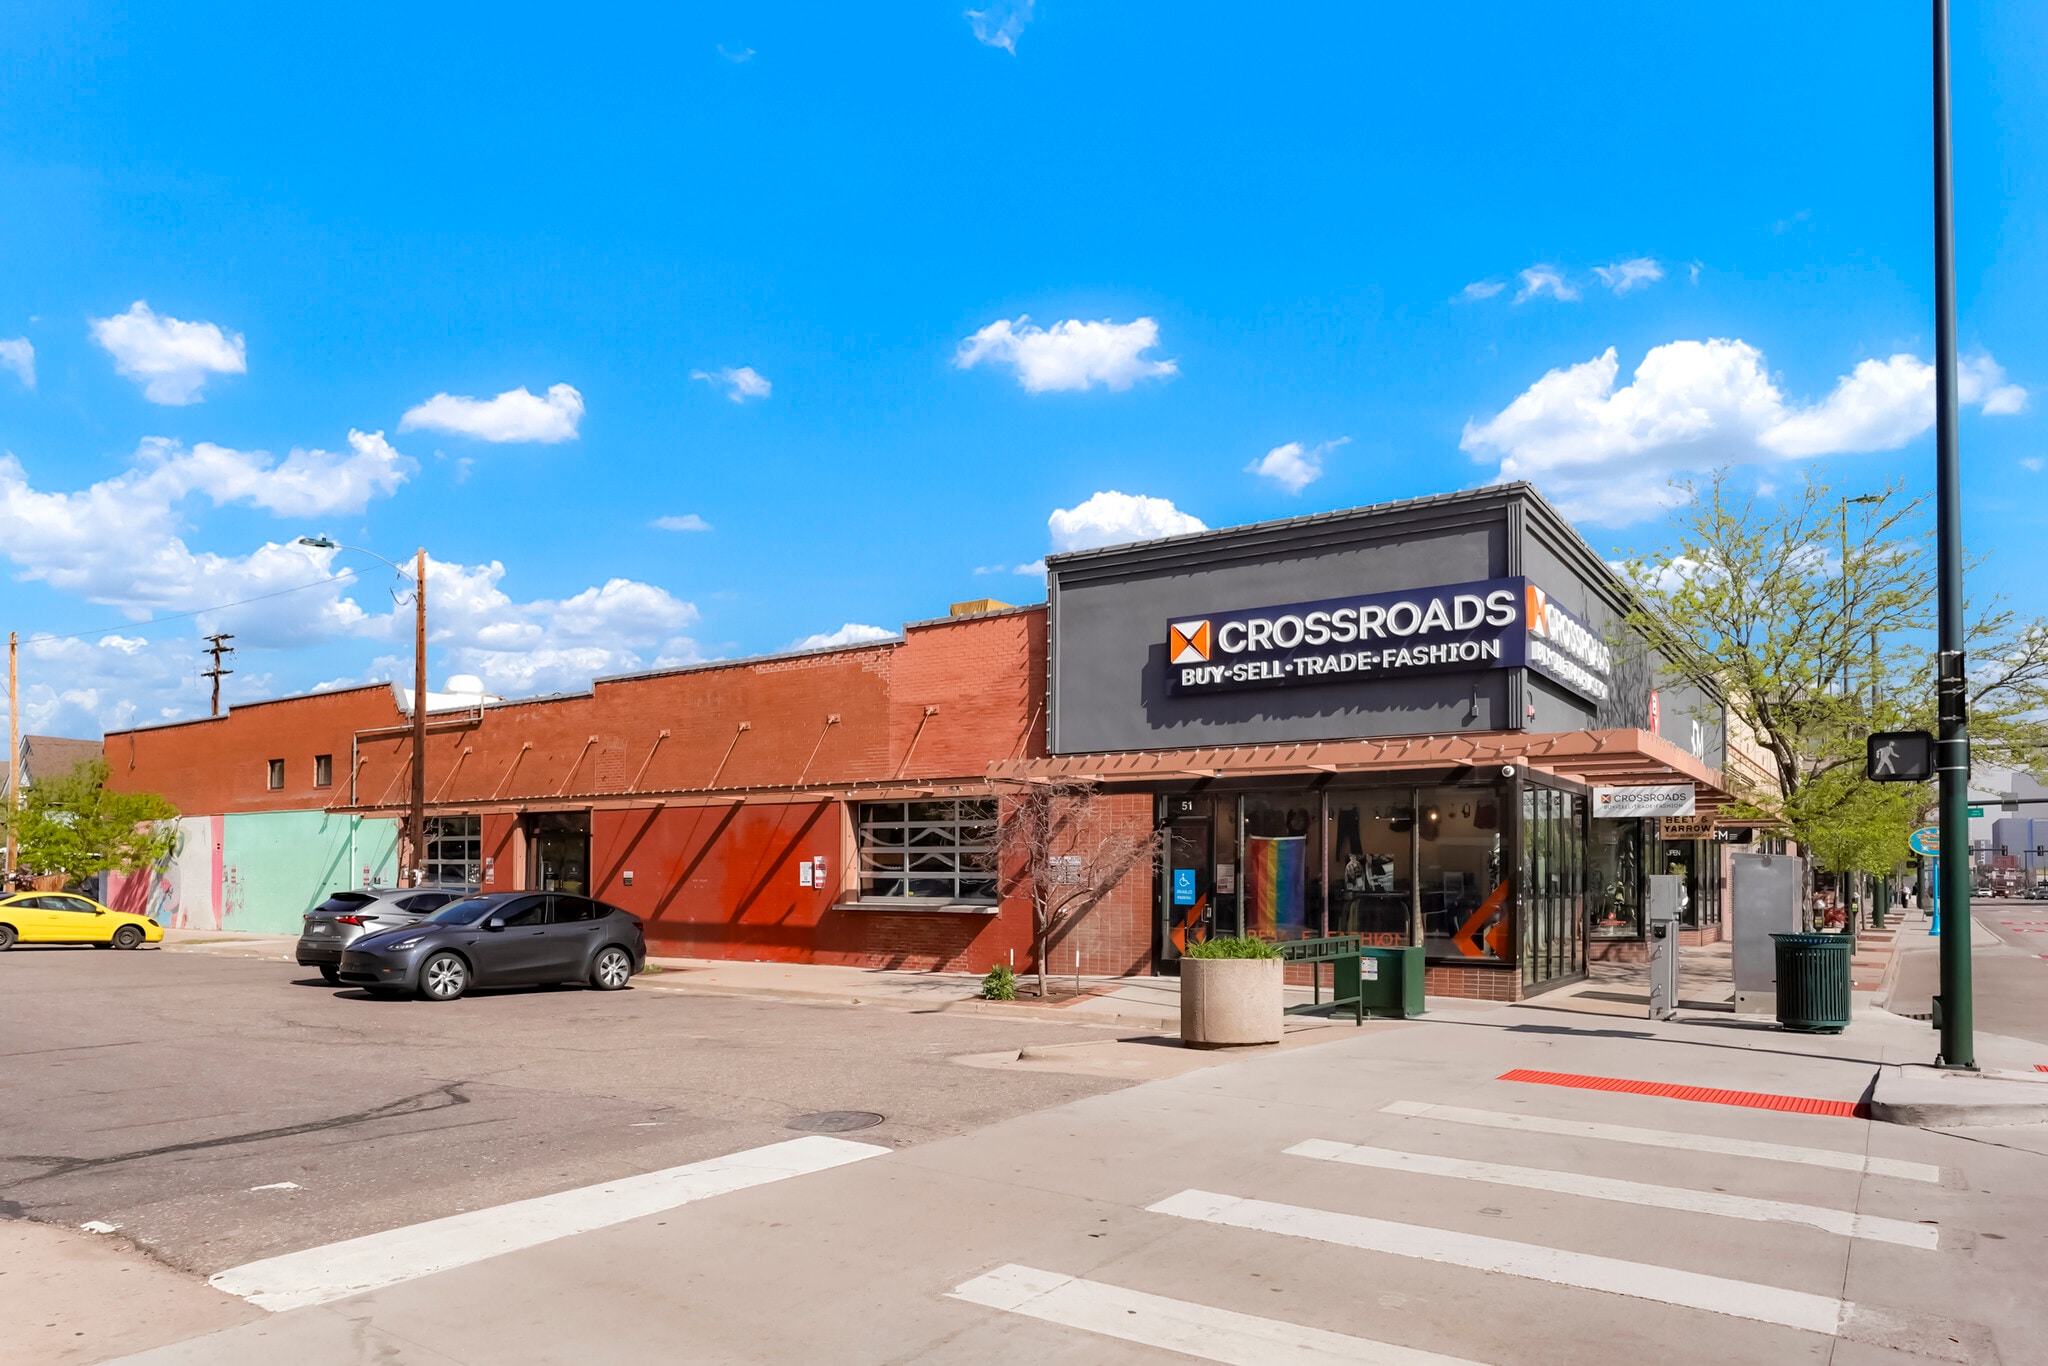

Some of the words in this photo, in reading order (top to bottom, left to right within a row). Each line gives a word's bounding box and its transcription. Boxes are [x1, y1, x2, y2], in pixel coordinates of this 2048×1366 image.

[1218, 590, 1517, 654] CROSSROADS
[1613, 792, 1687, 803] CROSSROADS
[1181, 801, 1193, 811] 51
[1665, 815, 1697, 824] BEET
[1663, 825, 1711, 833] YARROW
